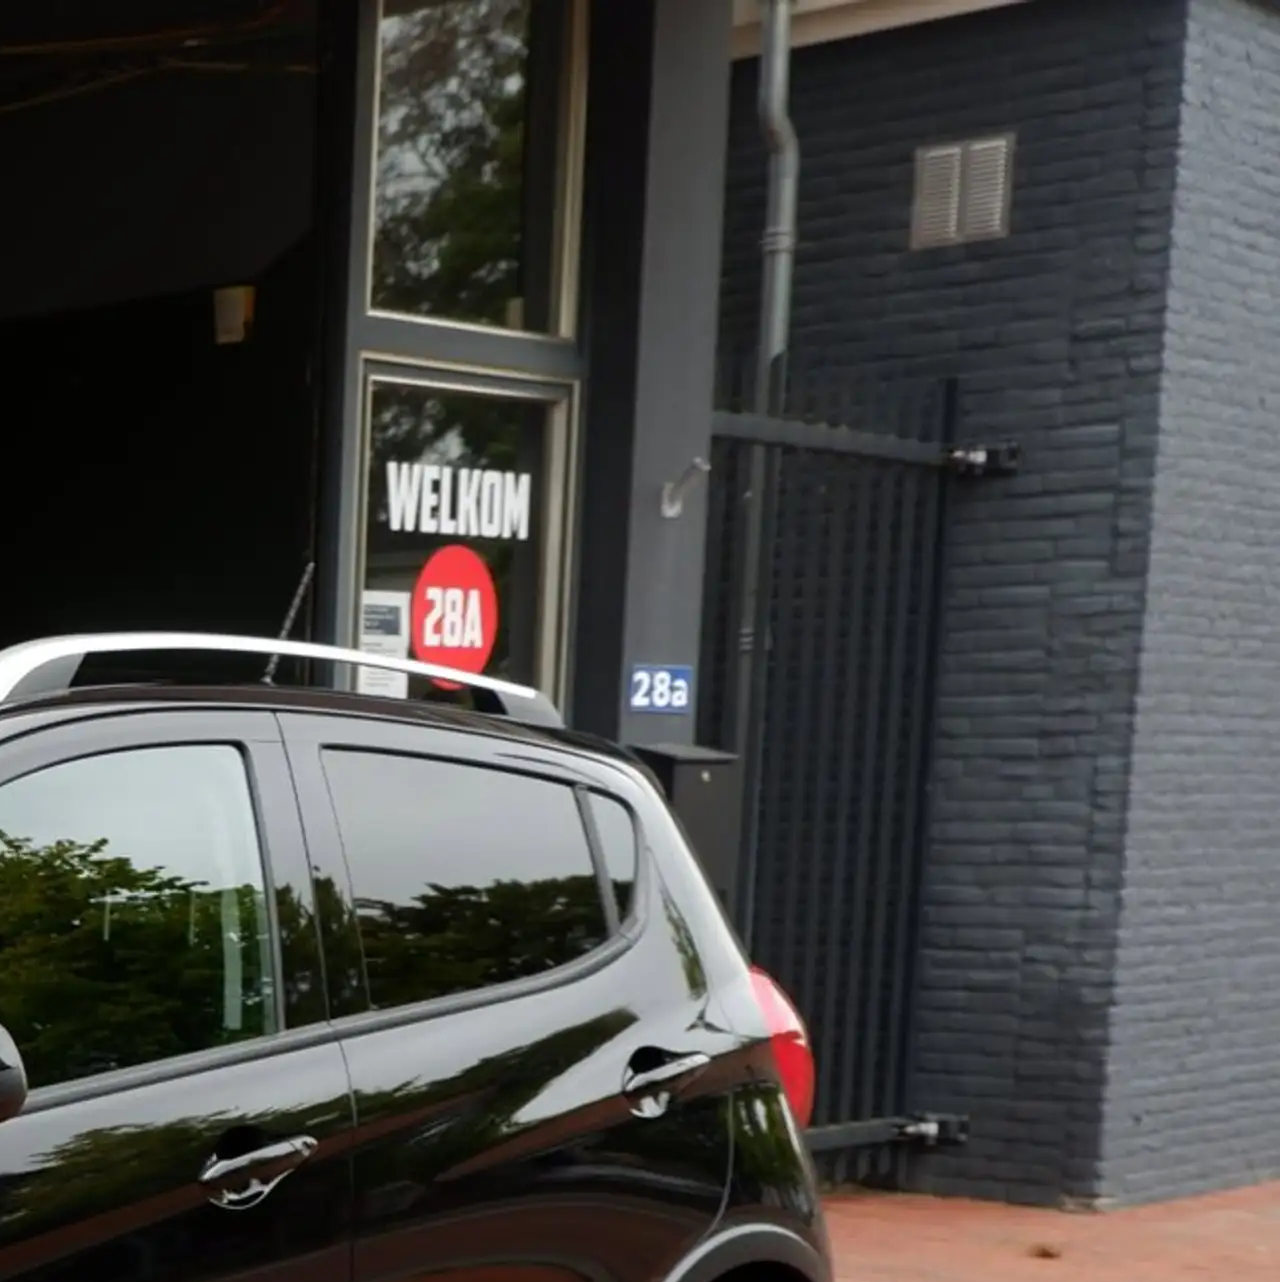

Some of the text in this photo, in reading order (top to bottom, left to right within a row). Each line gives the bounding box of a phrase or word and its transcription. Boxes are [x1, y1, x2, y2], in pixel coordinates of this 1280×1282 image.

[385, 460, 532, 541] WELKOM
[422, 585, 484, 650] 28A
[630, 670, 689, 709] 28a
